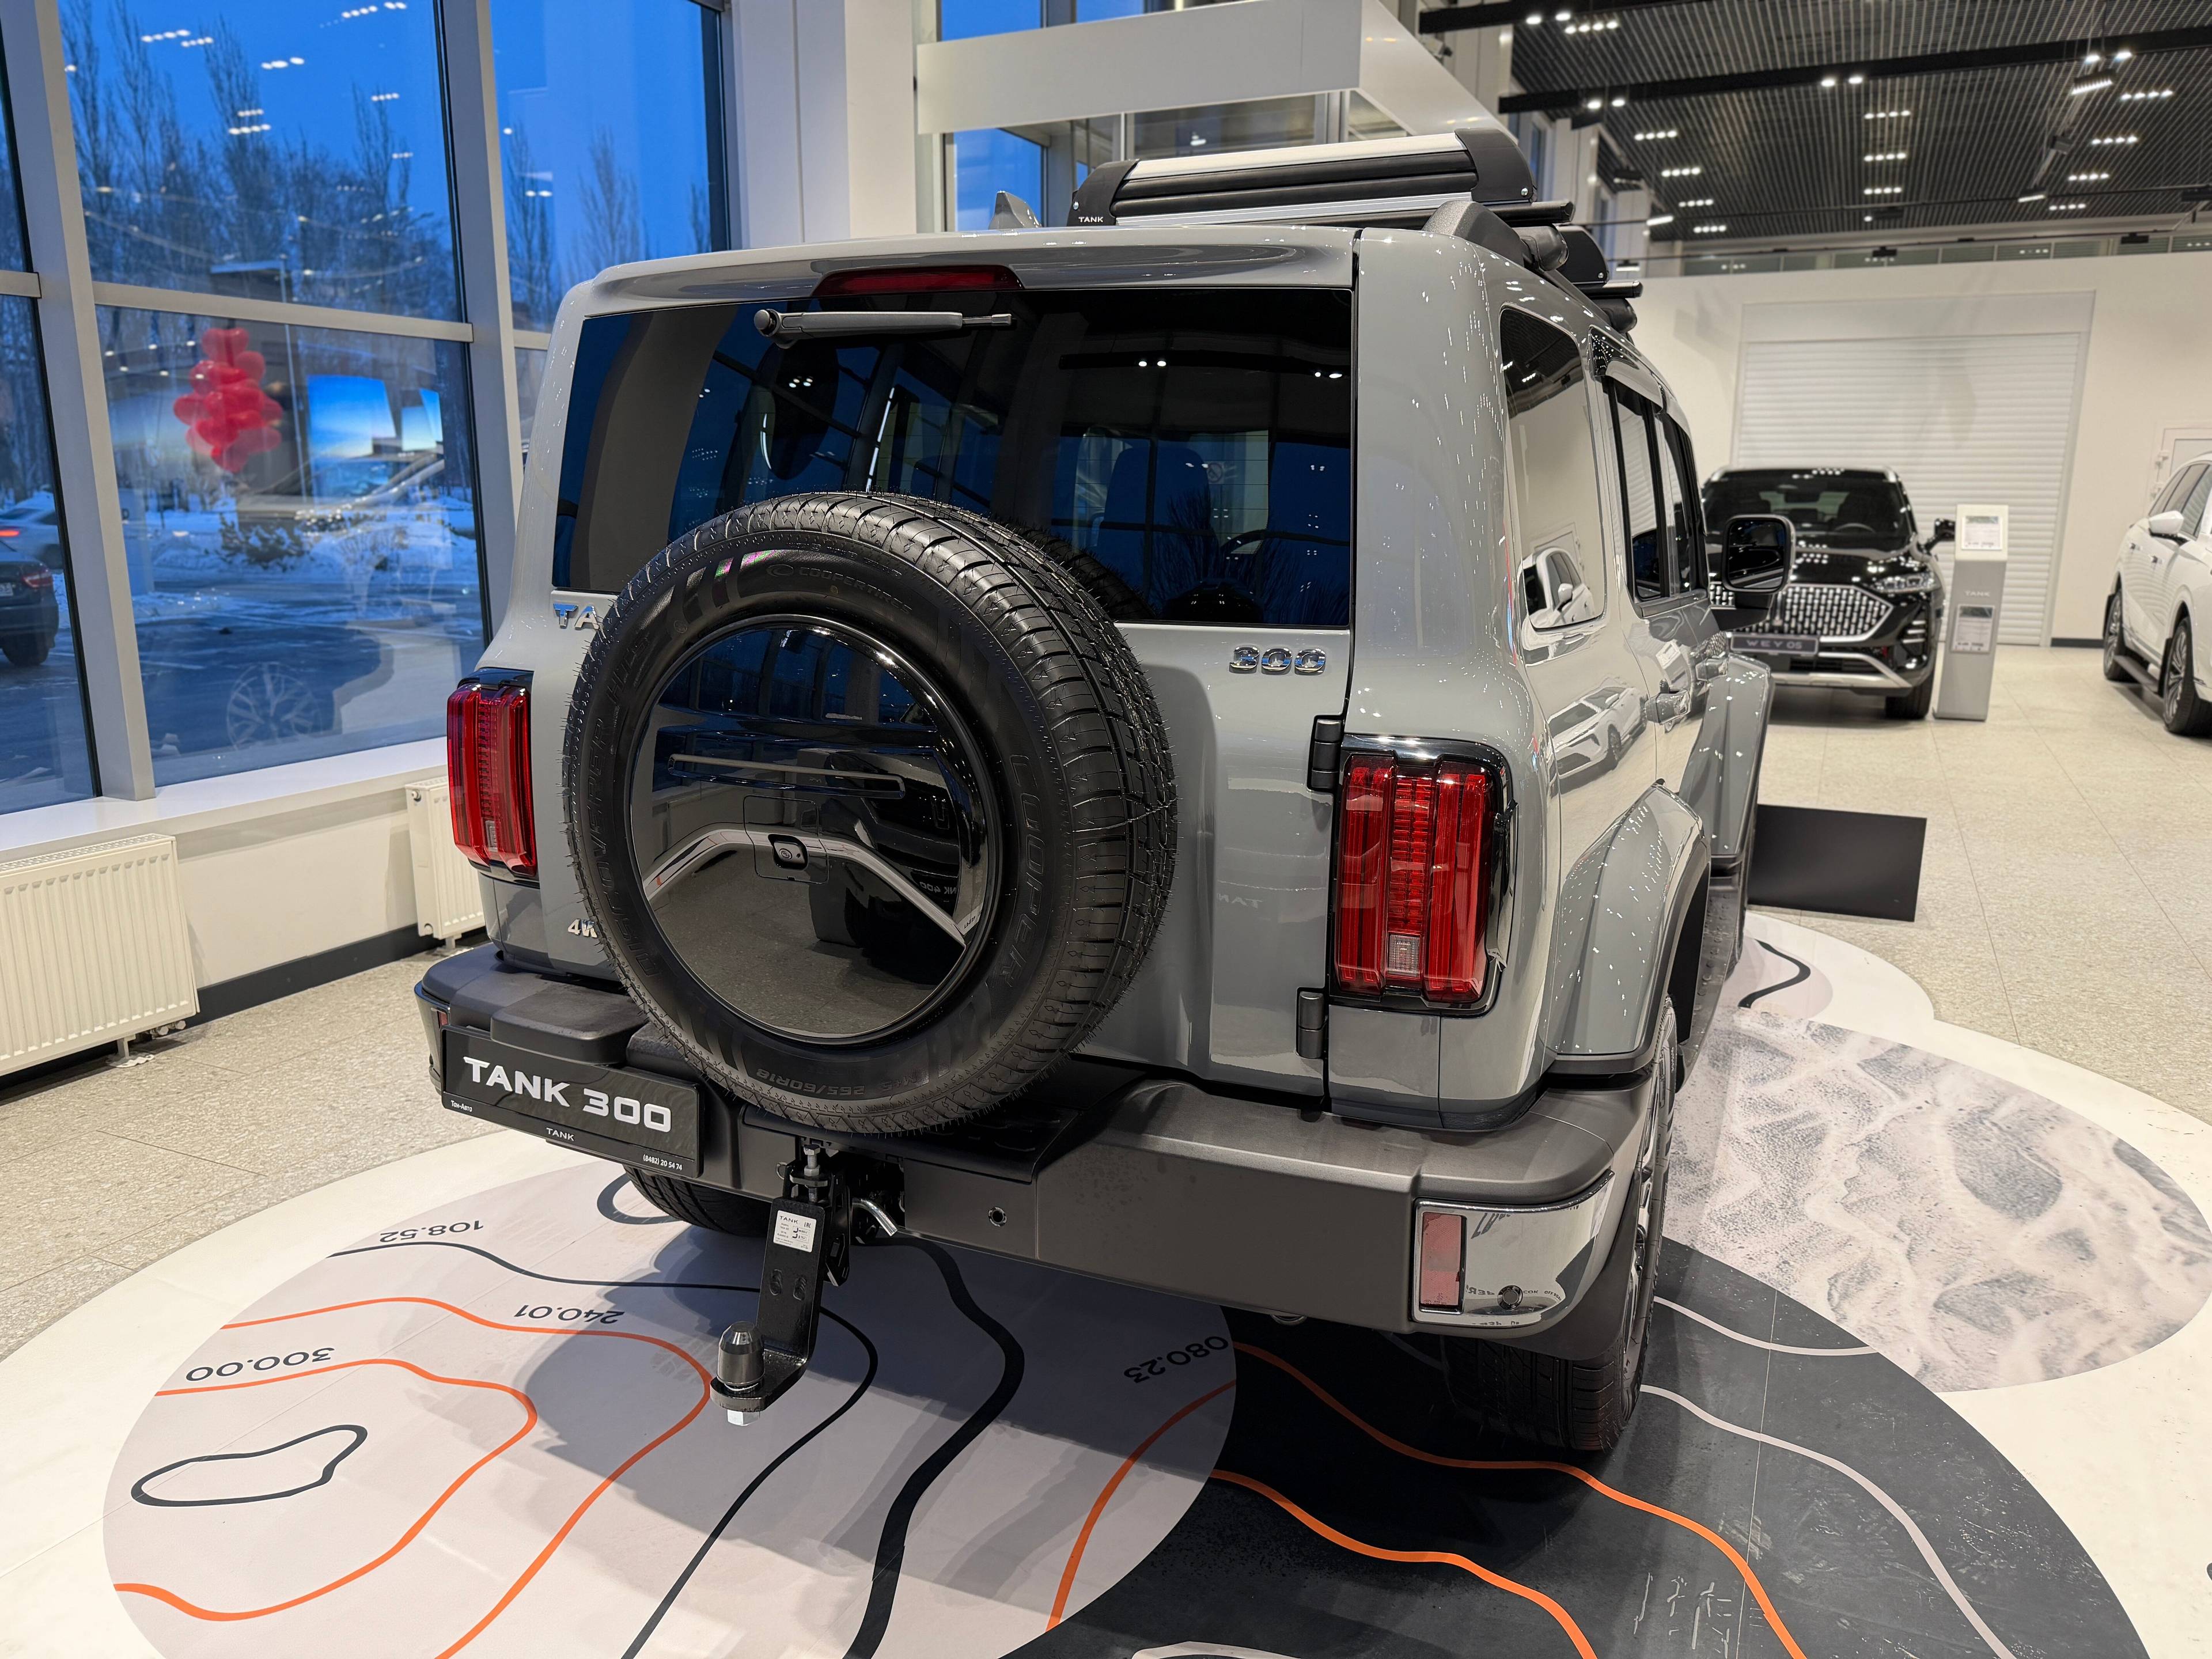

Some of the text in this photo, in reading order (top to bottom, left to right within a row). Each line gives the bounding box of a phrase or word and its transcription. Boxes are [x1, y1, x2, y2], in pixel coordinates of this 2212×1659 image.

[554, 603, 600, 631] TA
[1746, 639, 1783, 647] WEY
[1229, 646, 1325, 673] 300
[567, 918, 597, 938] 4W
[463, 1056, 671, 1132] TANK 300
[450, 1100, 473, 1112] Тон-Авто
[546, 1127, 575, 1142] TANK
[643, 1154, 660, 1165] (8482)
[779, 1215, 798, 1224] TANK
[379, 1219, 483, 1244] 108.52
[514, 1304, 625, 1324] 240.01
[185, 1346, 335, 1381] 300.00
[1123, 1336, 1229, 1384] 080.23
